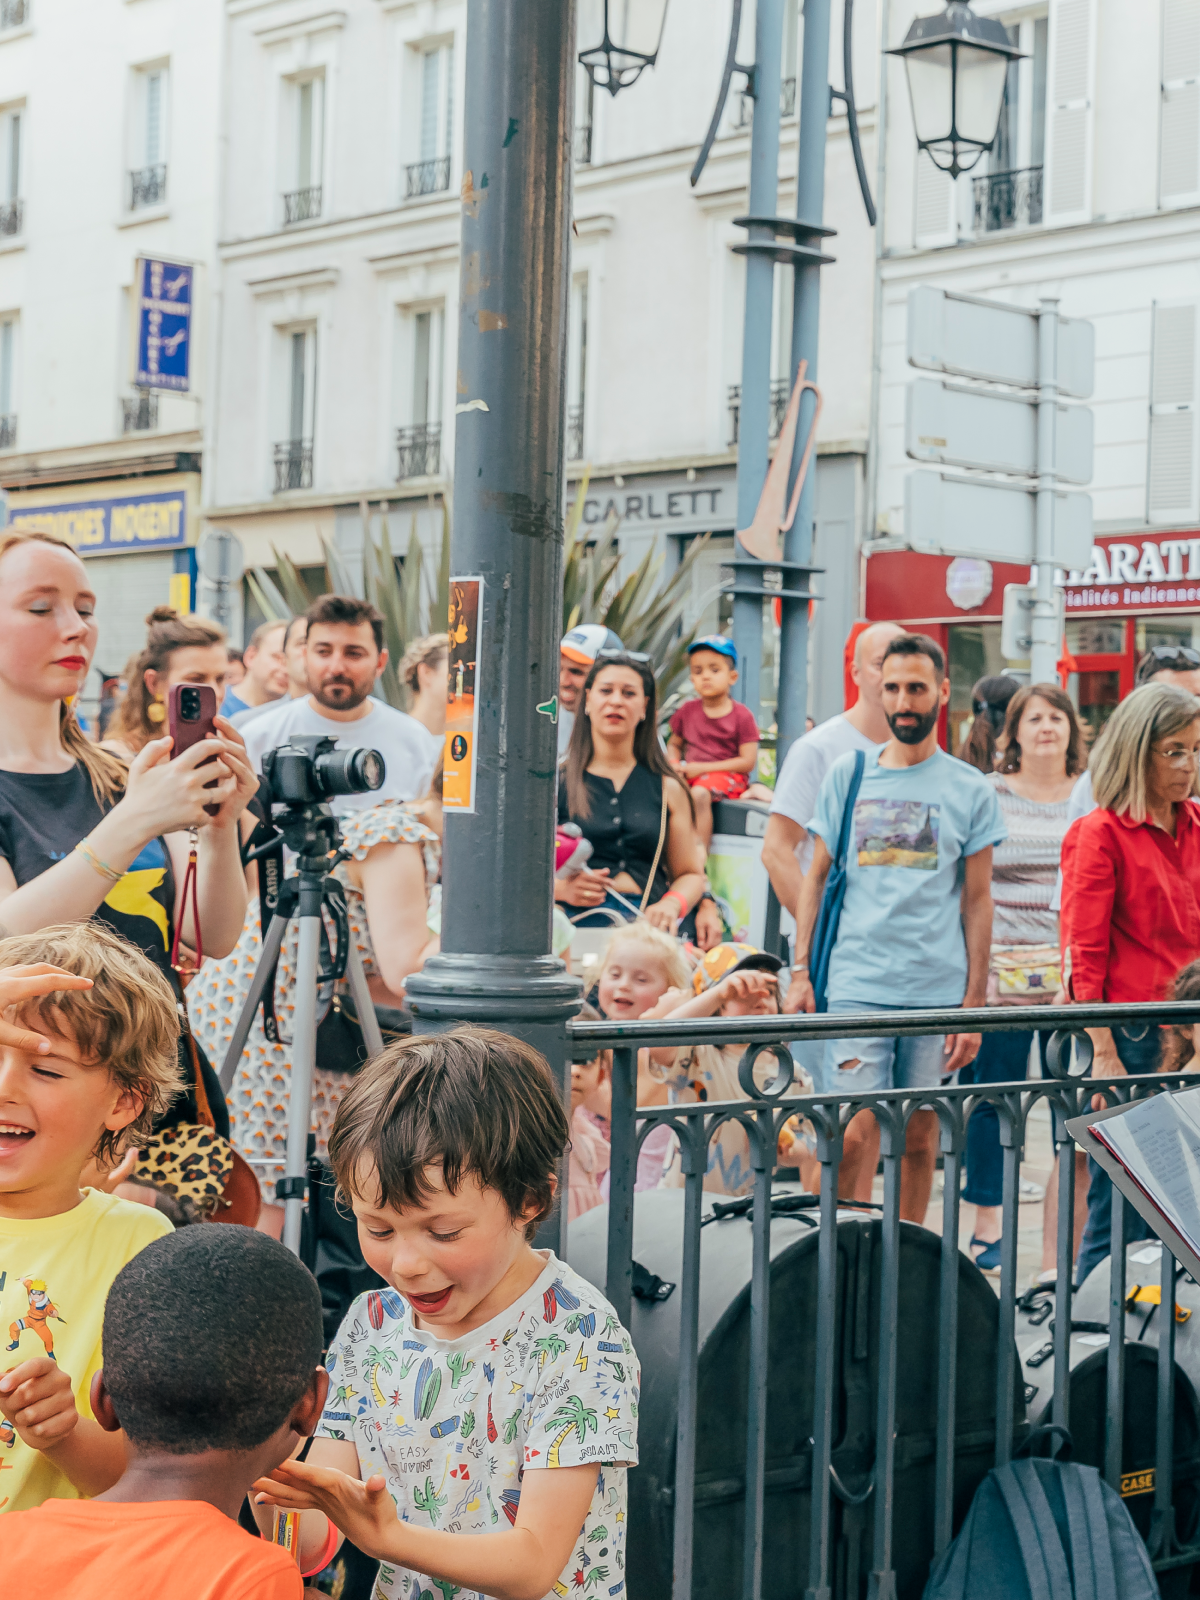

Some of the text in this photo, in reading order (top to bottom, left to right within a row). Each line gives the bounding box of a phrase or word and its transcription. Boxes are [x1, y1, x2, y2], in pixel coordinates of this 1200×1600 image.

[567, 488, 722, 525] CARLETT
[110, 499, 182, 542] NOGENT
[1066, 588, 1119, 607] ialités
[265, 859, 279, 909] Canon
[504, 1347, 518, 1377] EASY
[538, 1372, 565, 1397] EASY
[400, 1446, 430, 1460] EASY
[1121, 1474, 1153, 1492] CASE
